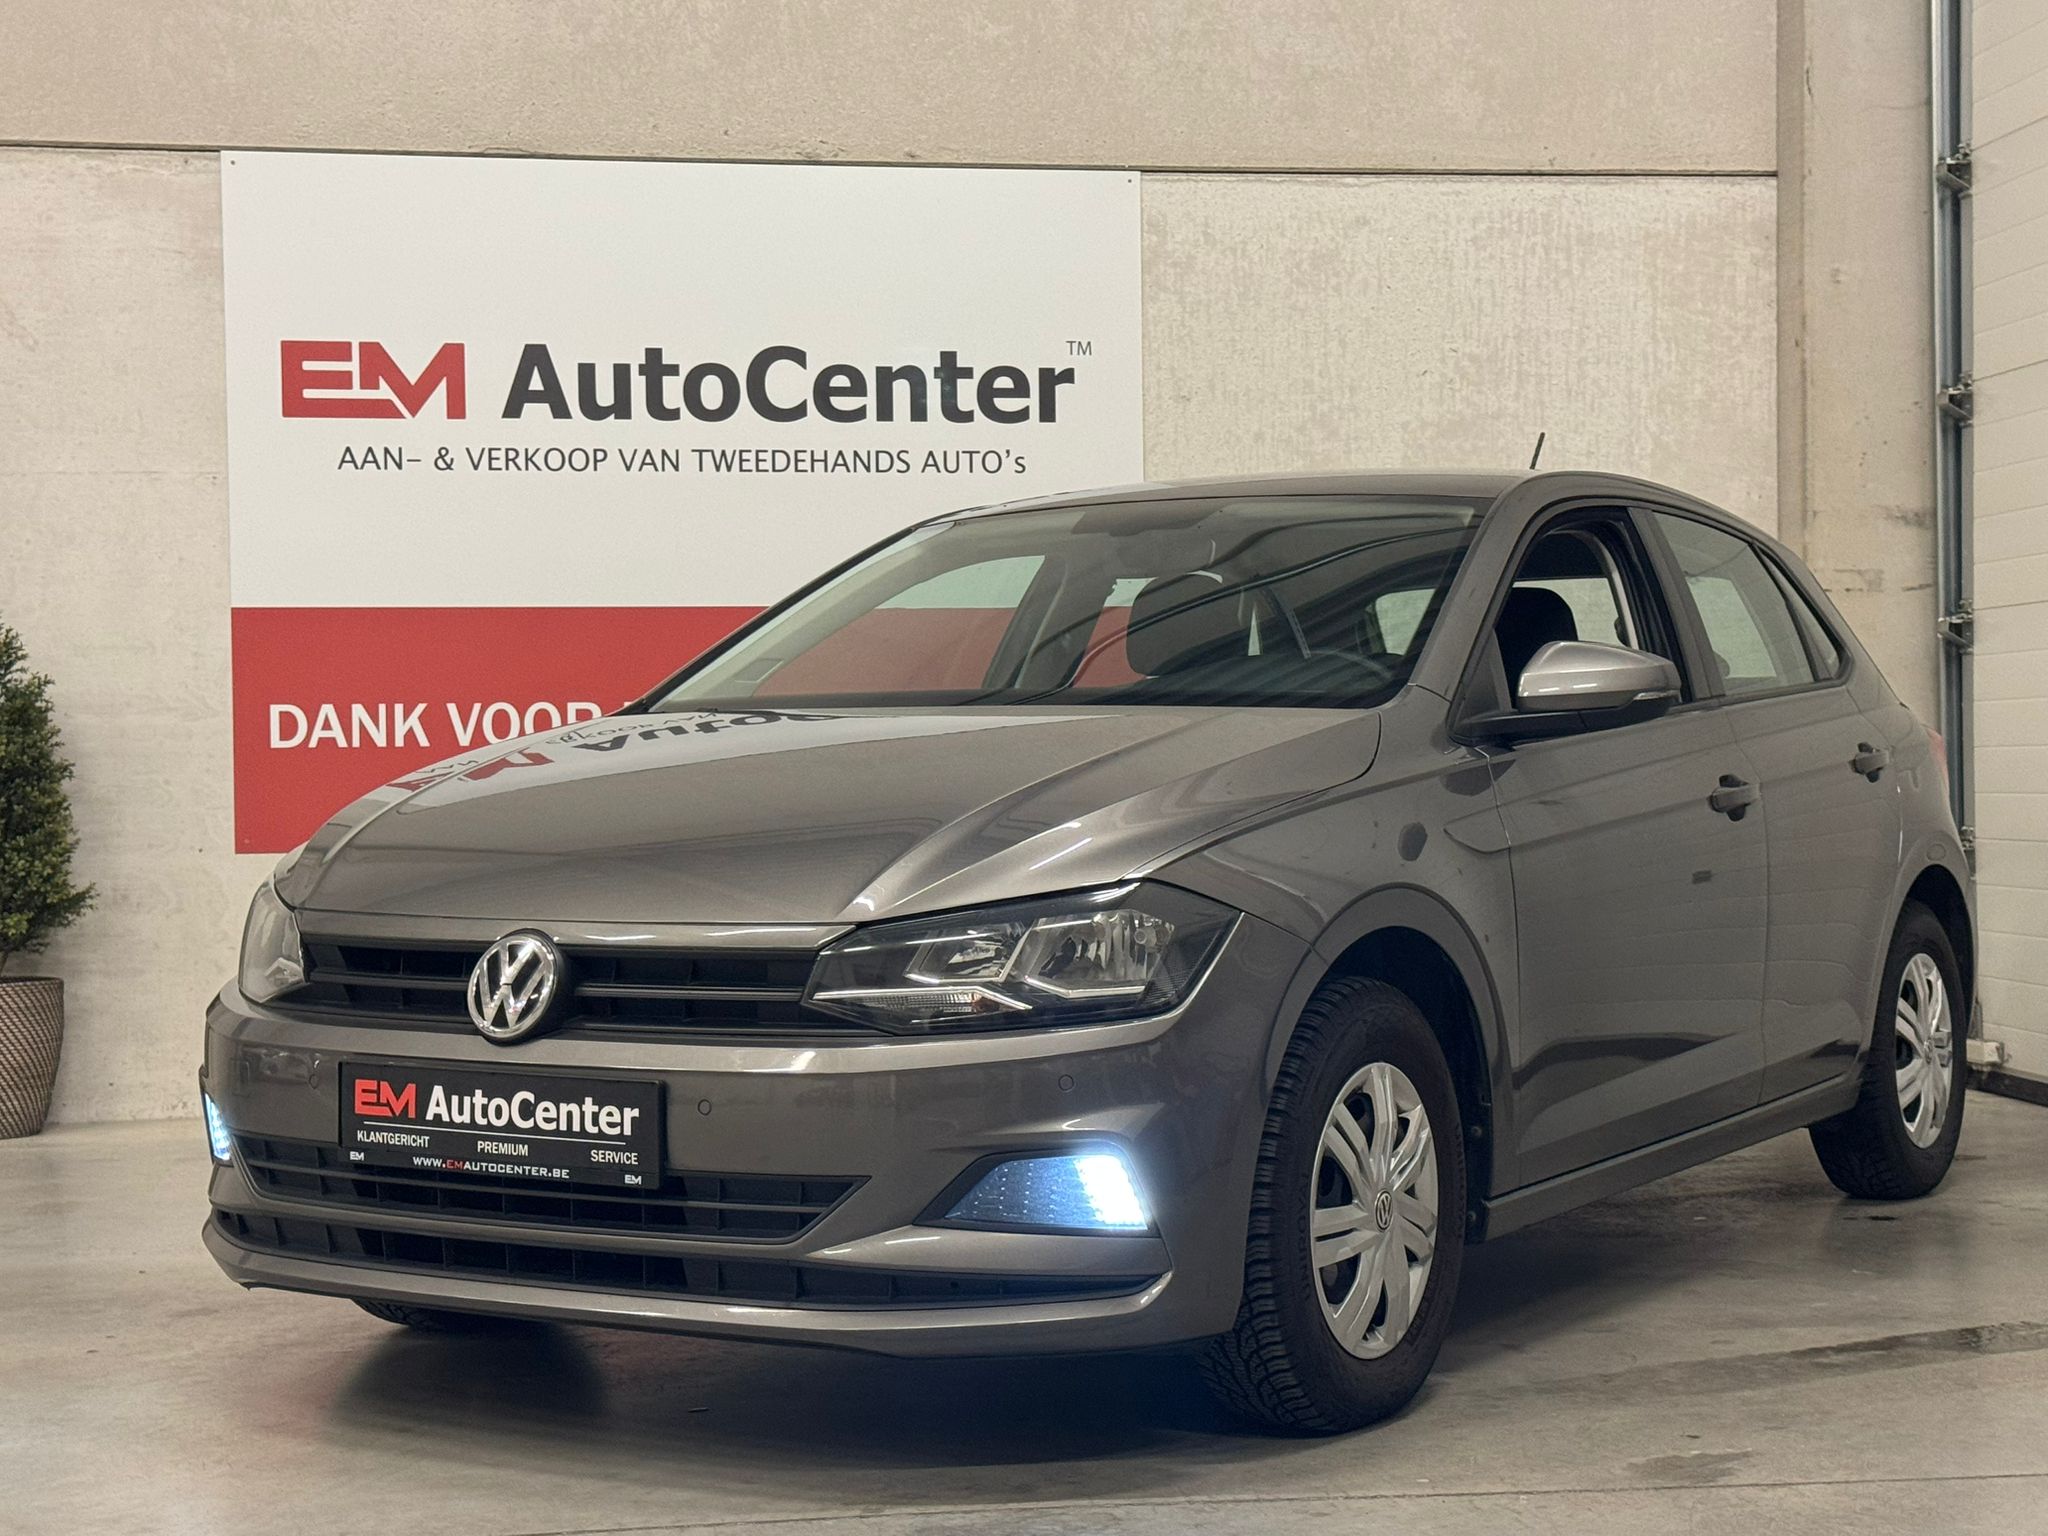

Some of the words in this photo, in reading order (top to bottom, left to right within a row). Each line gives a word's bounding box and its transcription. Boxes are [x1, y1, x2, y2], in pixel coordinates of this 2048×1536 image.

[281, 341, 466, 419] EM
[502, 344, 1075, 423] AutoCenter
[1065, 341, 1092, 356] TM
[434, 446, 454, 471] &
[466, 447, 608, 472] VERKOOP
[618, 448, 680, 472] VAN
[691, 449, 910, 473] TWEEDEHANDS
[269, 703, 430, 749] DANK
[354, 1078, 417, 1119] EM
[425, 1084, 640, 1136] AutoCenter
[350, 1151, 365, 1161] EM
[356, 1129, 430, 1148] KLANTGERICHT
[477, 1140, 529, 1157] PREMIUM
[590, 1149, 639, 1165] SERVICE
[412, 1156, 570, 1179] WWW.EMAUTOCENTER.BE
[624, 1174, 642, 1185] EM
